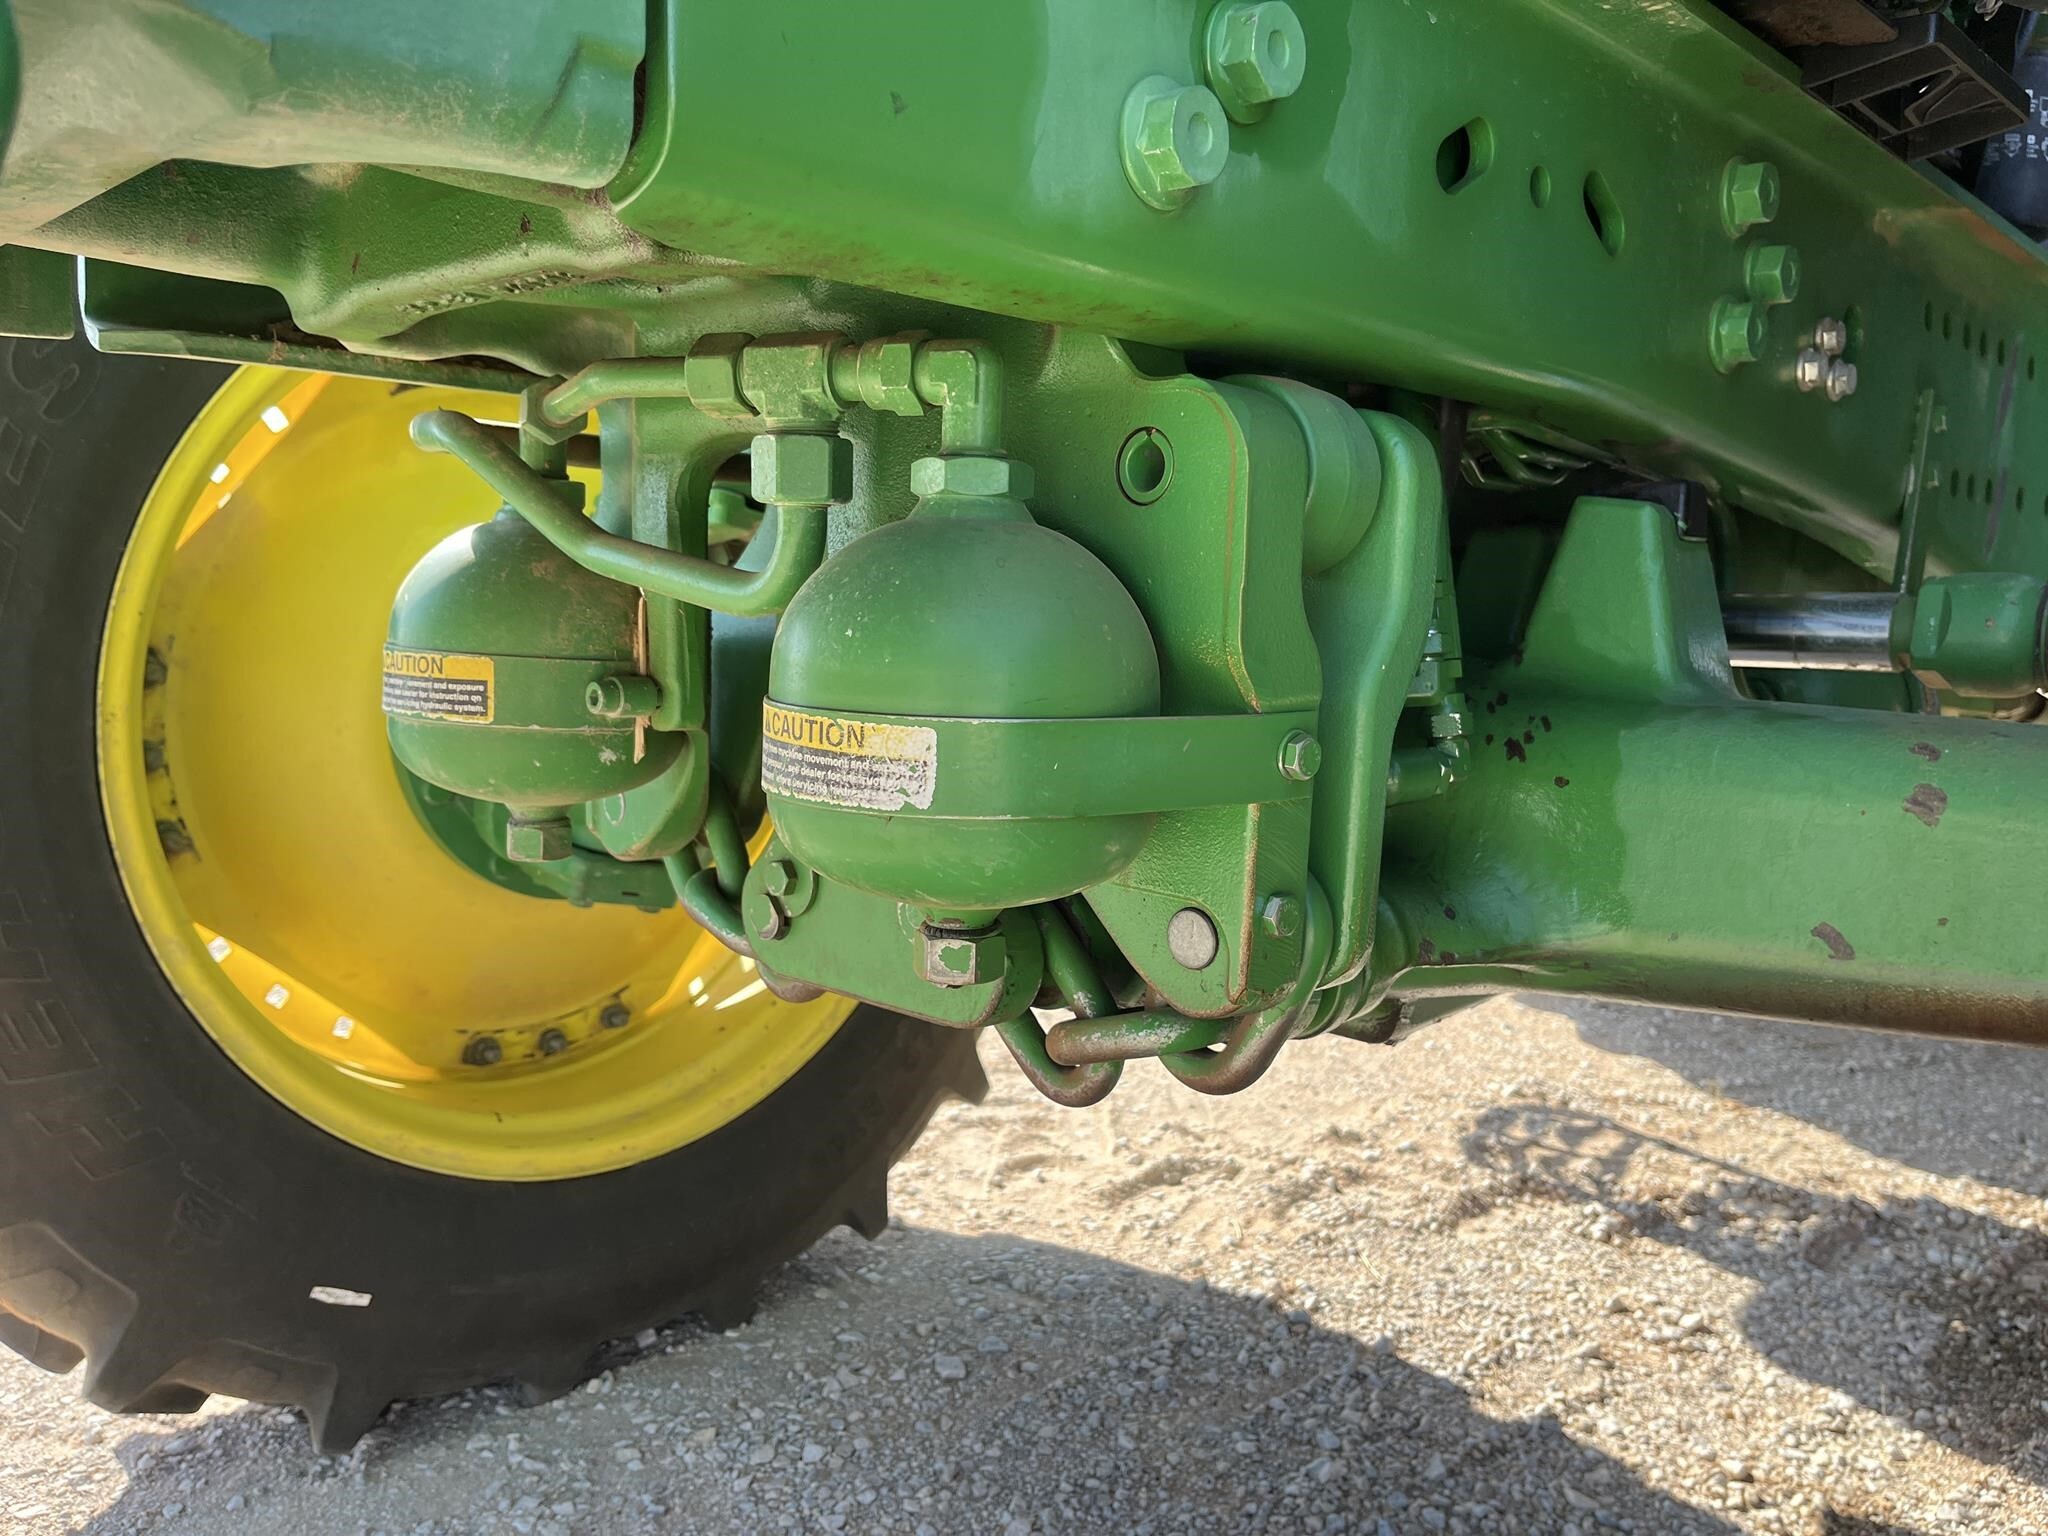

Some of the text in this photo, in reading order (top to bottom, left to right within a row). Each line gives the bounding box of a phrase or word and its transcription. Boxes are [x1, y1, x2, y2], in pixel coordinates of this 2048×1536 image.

[385, 653, 443, 675] CAUTION
[433, 681, 447, 690] and
[448, 683, 485, 693] exposure
[429, 692, 469, 702] instruction
[454, 704, 486, 713] system.
[772, 711, 865, 749] CAUTION
